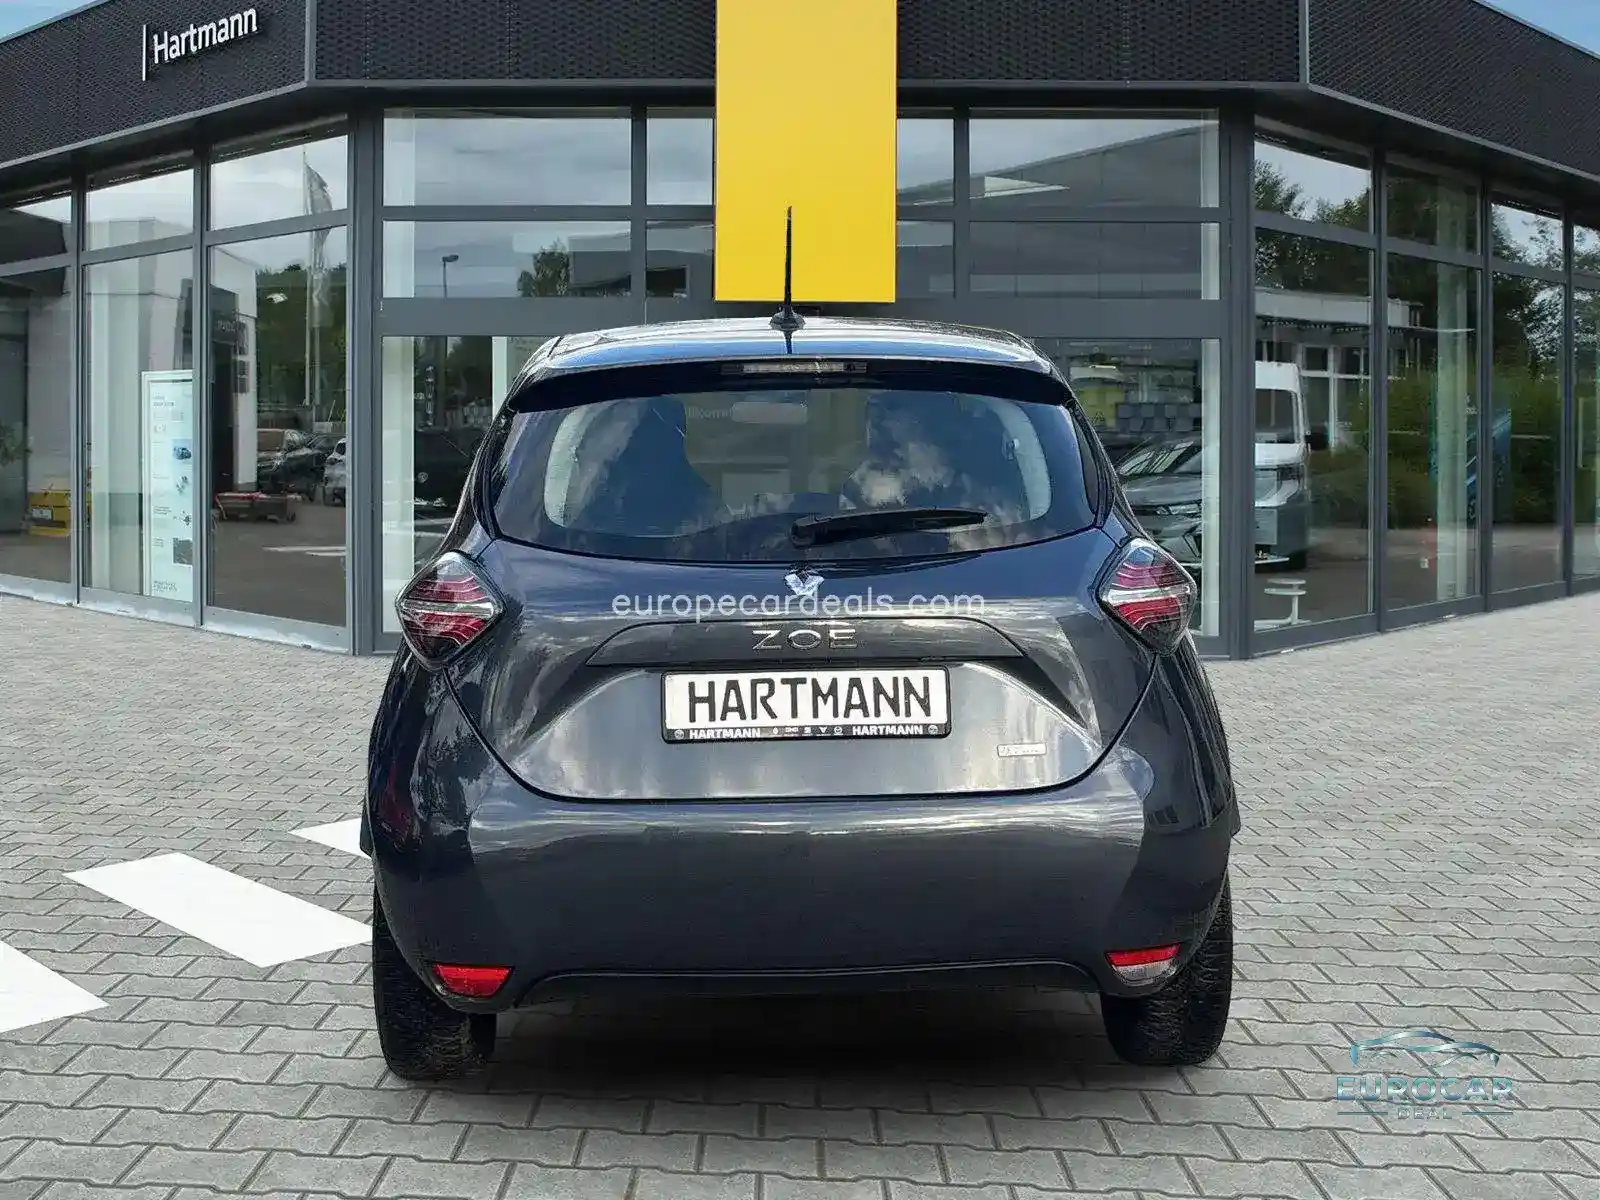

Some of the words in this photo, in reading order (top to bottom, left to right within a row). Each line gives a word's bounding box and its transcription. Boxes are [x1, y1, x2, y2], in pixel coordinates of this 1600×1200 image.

[153, 7, 258, 65] Hartmann
[751, 628, 859, 651] ZOE
[688, 676, 932, 723] HARTMANN
[689, 728, 761, 739] HARTMANN
[852, 726, 924, 736] HARTMANN
